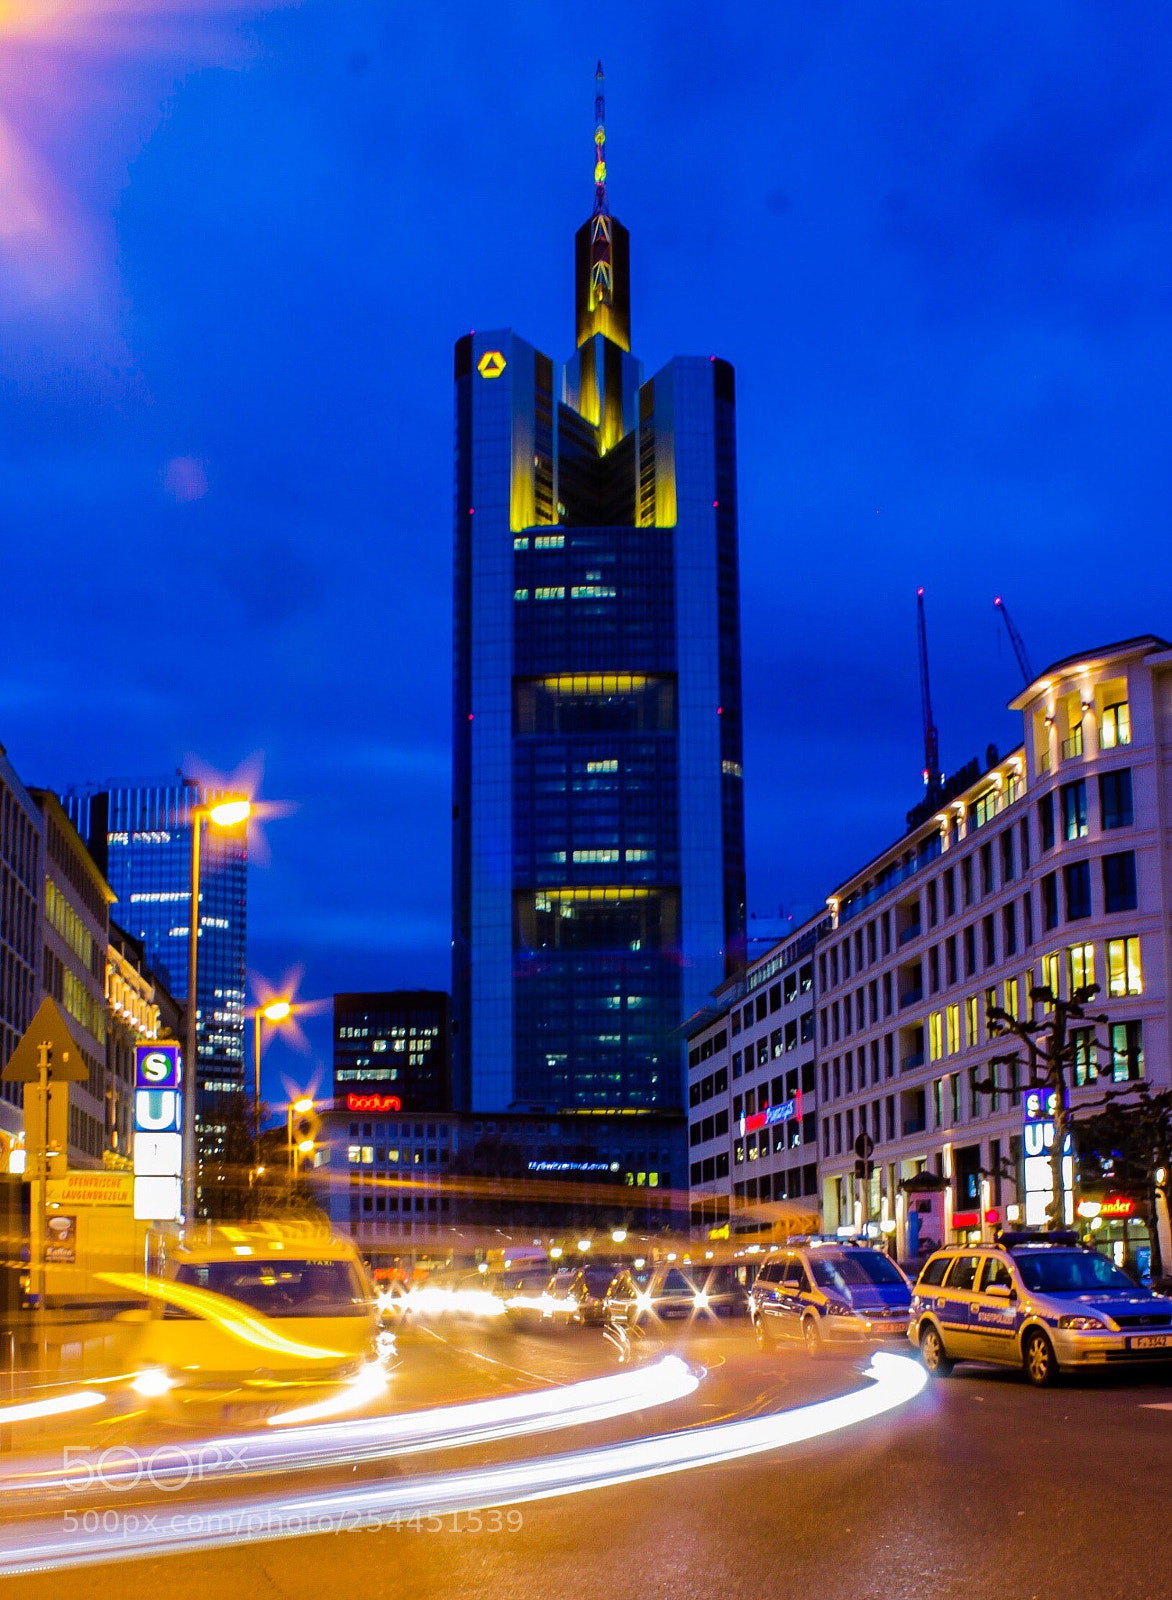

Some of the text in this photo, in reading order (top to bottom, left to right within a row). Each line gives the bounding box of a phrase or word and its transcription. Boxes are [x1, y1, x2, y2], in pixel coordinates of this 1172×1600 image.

[145, 1053, 168, 1081] S
[136, 1090, 175, 1130] U
[347, 1093, 401, 1111] bodum
[1024, 1123, 1043, 1155] U
[68, 1176, 122, 1188] OFENFRISCHE
[61, 1190, 128, 1201] LAUGENBREZELN
